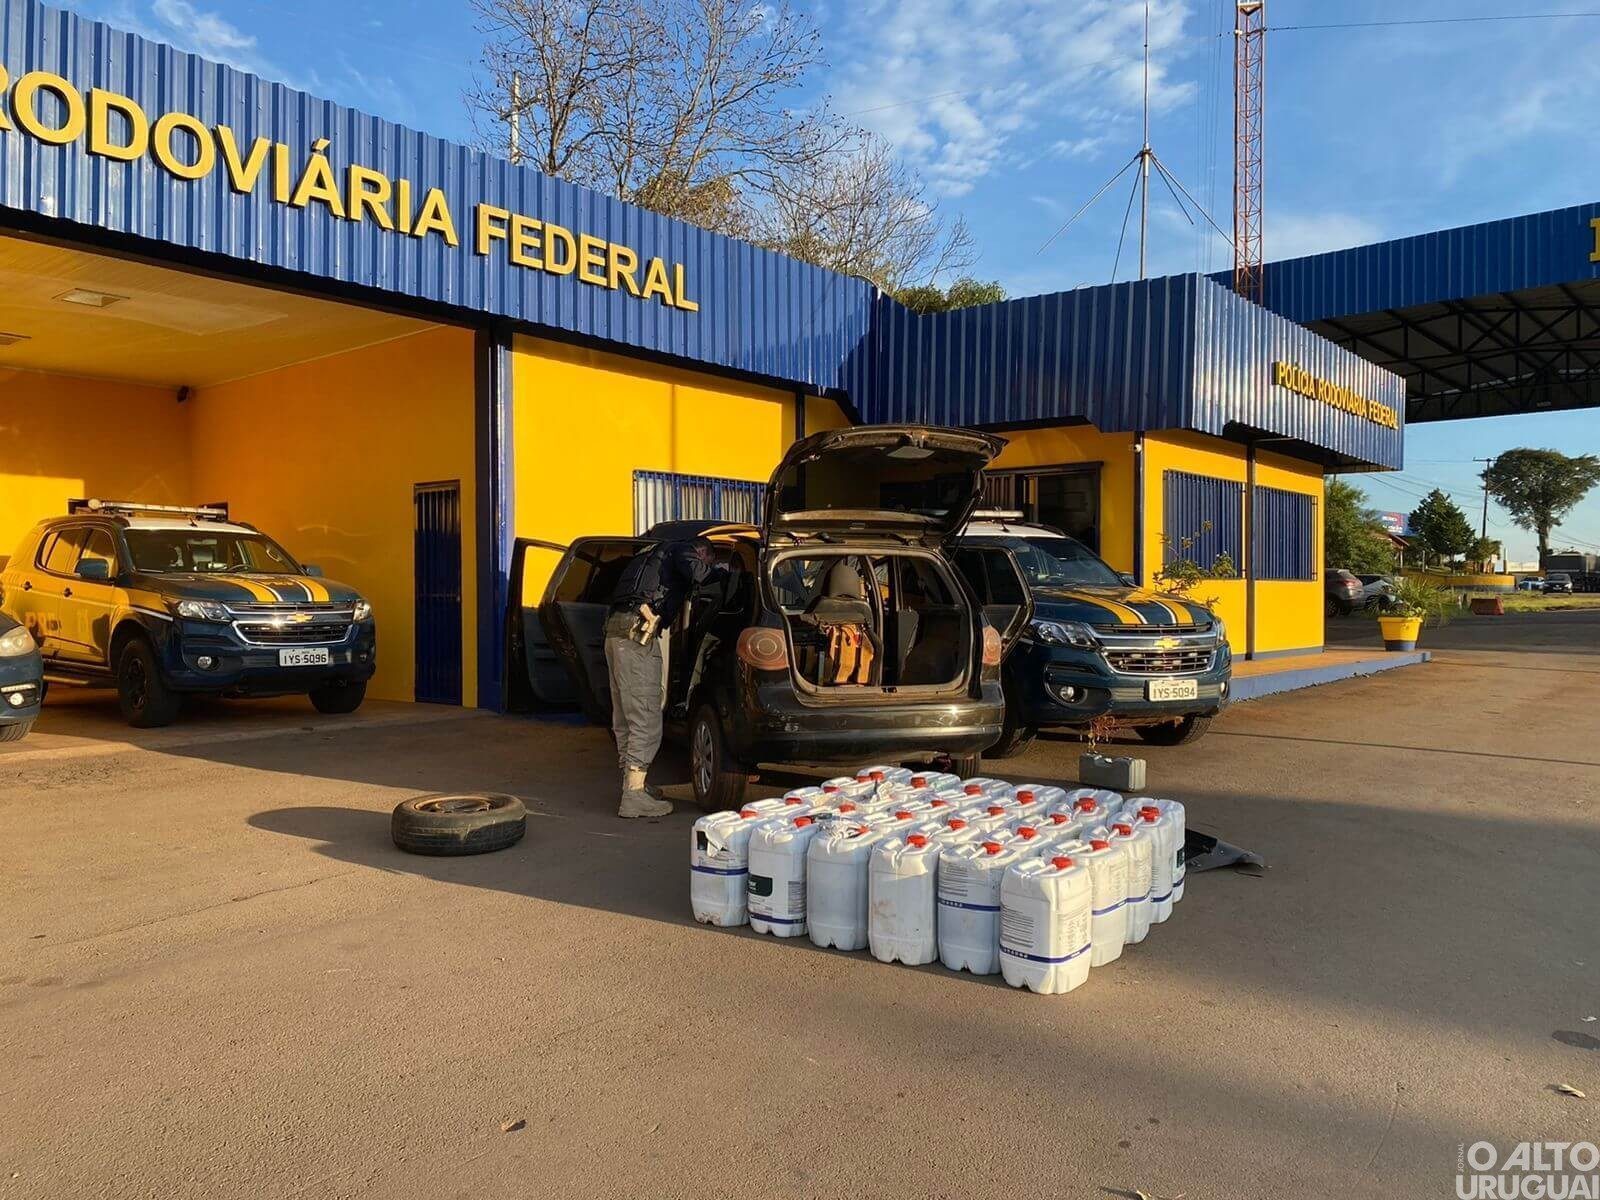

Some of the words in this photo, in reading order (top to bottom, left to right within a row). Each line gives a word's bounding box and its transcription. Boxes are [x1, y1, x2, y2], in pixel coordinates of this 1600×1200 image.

[0, 66, 459, 247] ODOVIÁRIA
[476, 202, 699, 312] FEDERAL
[1369, 399, 1399, 430] FEDERAL
